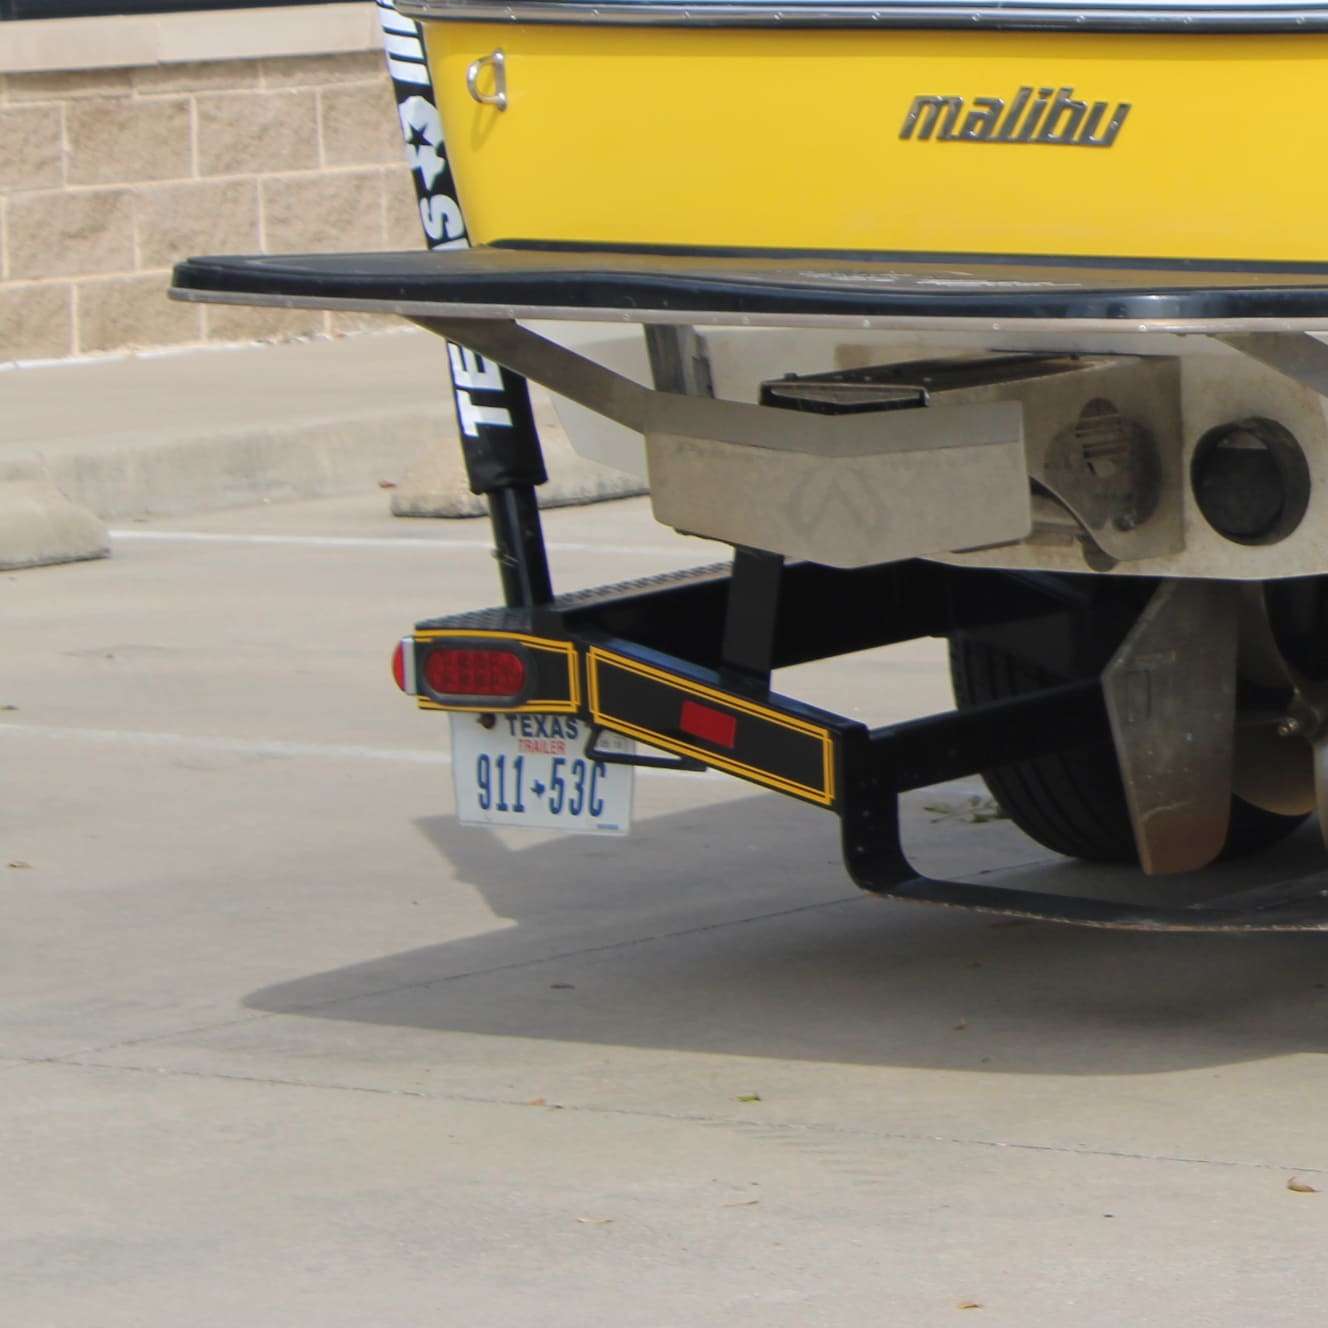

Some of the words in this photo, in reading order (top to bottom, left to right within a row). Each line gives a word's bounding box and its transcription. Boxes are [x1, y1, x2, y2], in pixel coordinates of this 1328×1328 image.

[898, 85, 1132, 149] malibu
[504, 714, 579, 740] TEXAS
[517, 738, 569, 755] TRAILER
